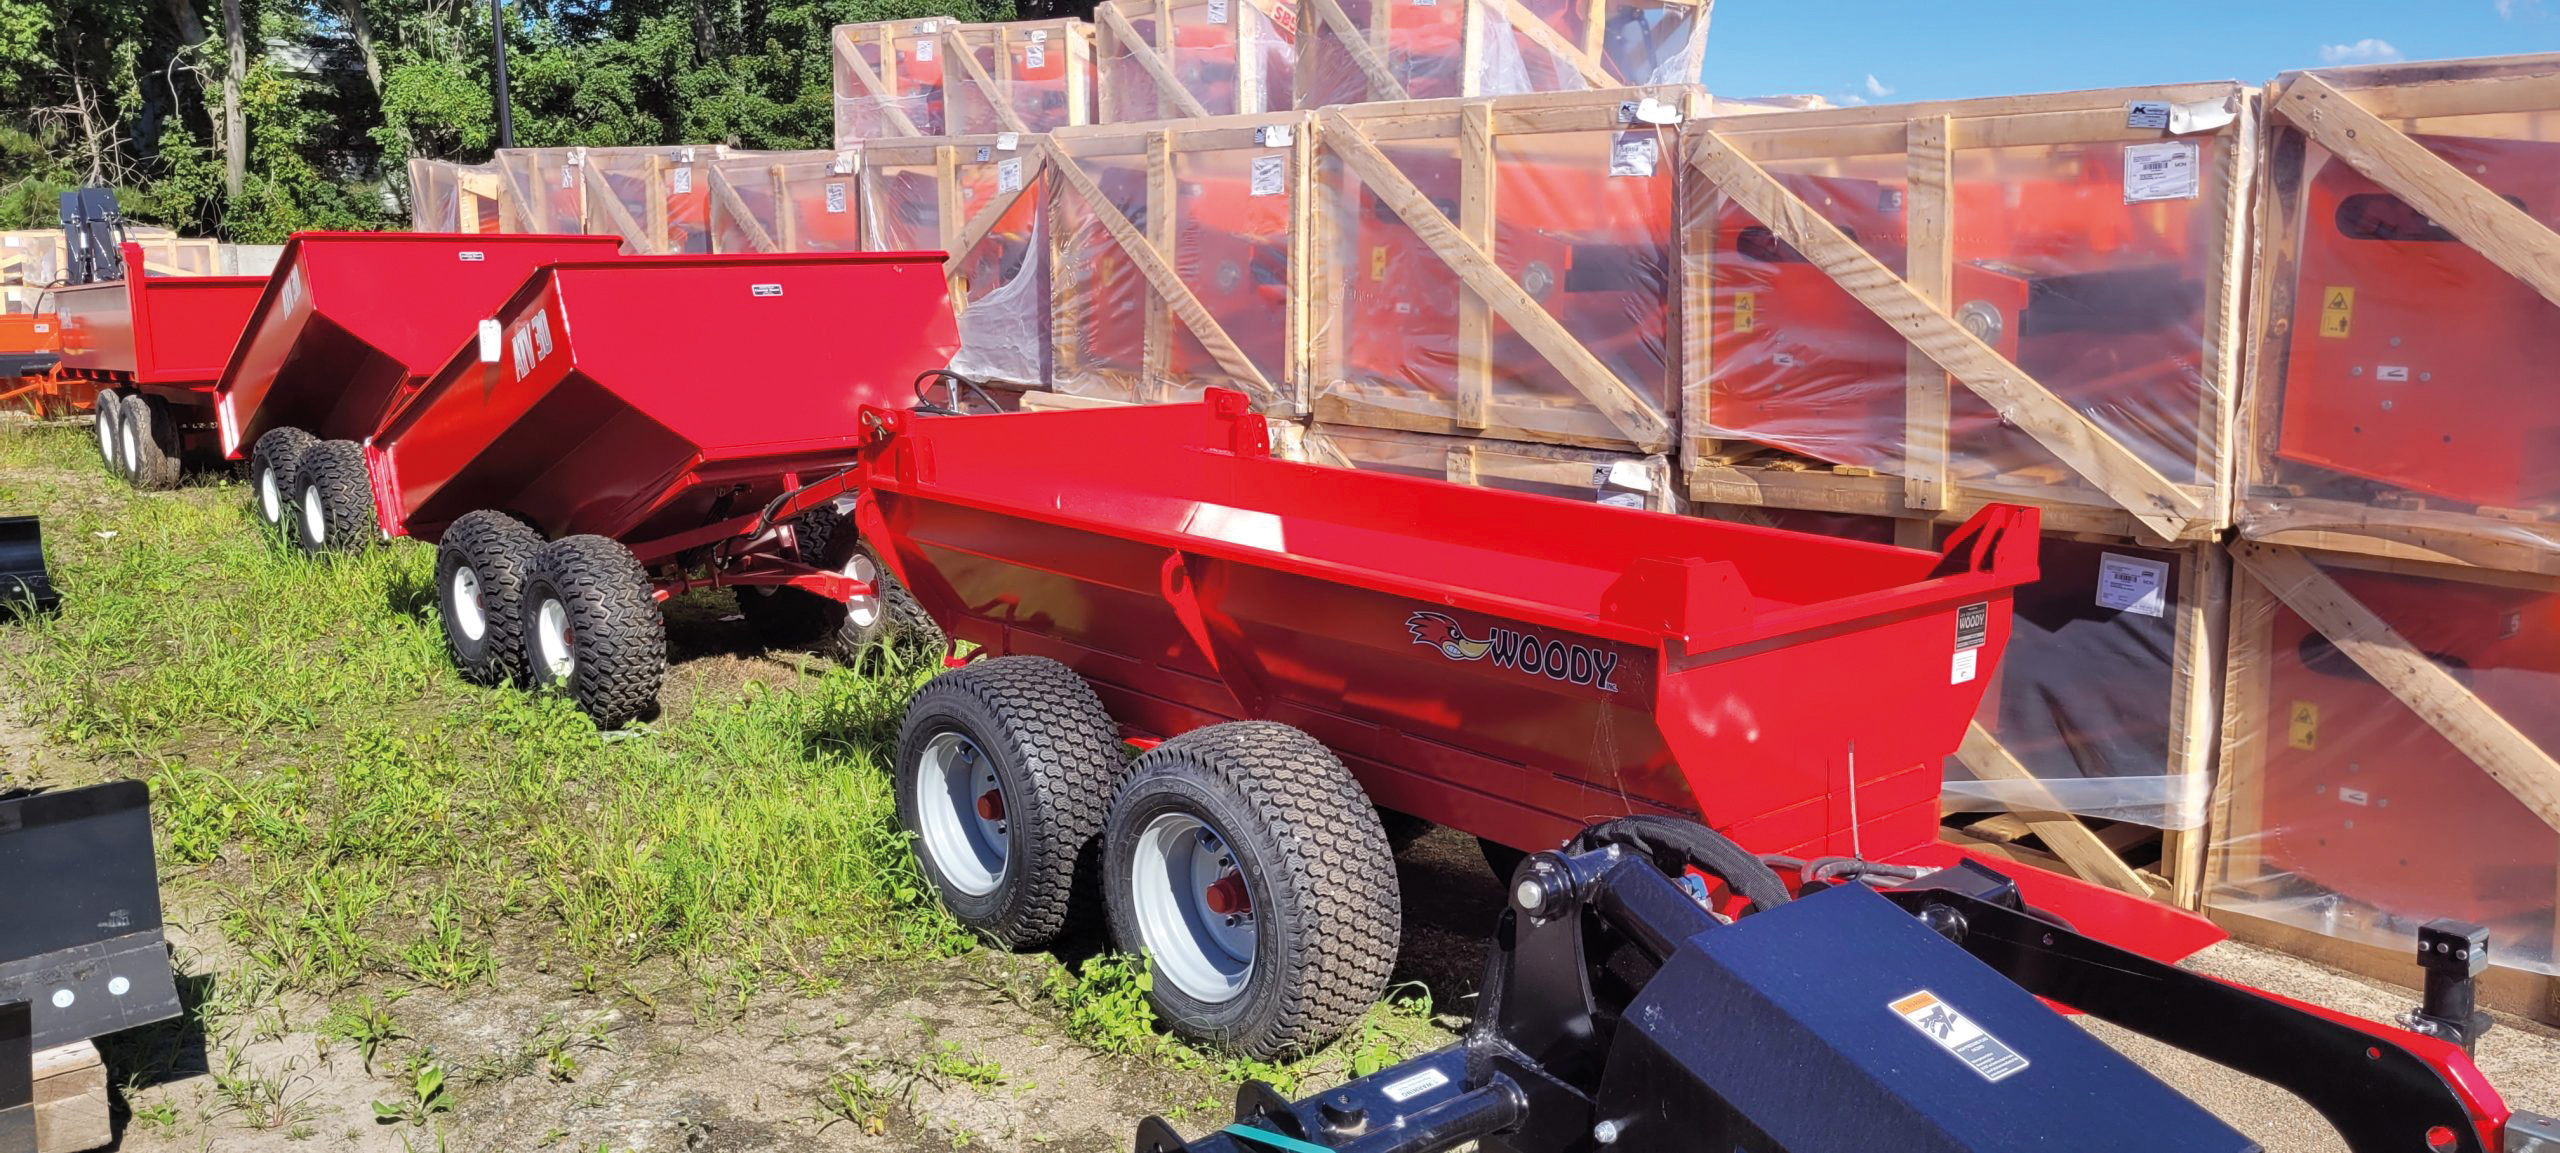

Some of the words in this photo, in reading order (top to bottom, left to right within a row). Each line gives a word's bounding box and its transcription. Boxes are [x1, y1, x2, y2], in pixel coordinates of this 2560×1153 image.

[512, 322, 536, 383] ATV
[531, 308, 553, 362] 30
[1960, 613, 1985, 630] WOODY
[1490, 627, 1618, 690] WOODY
